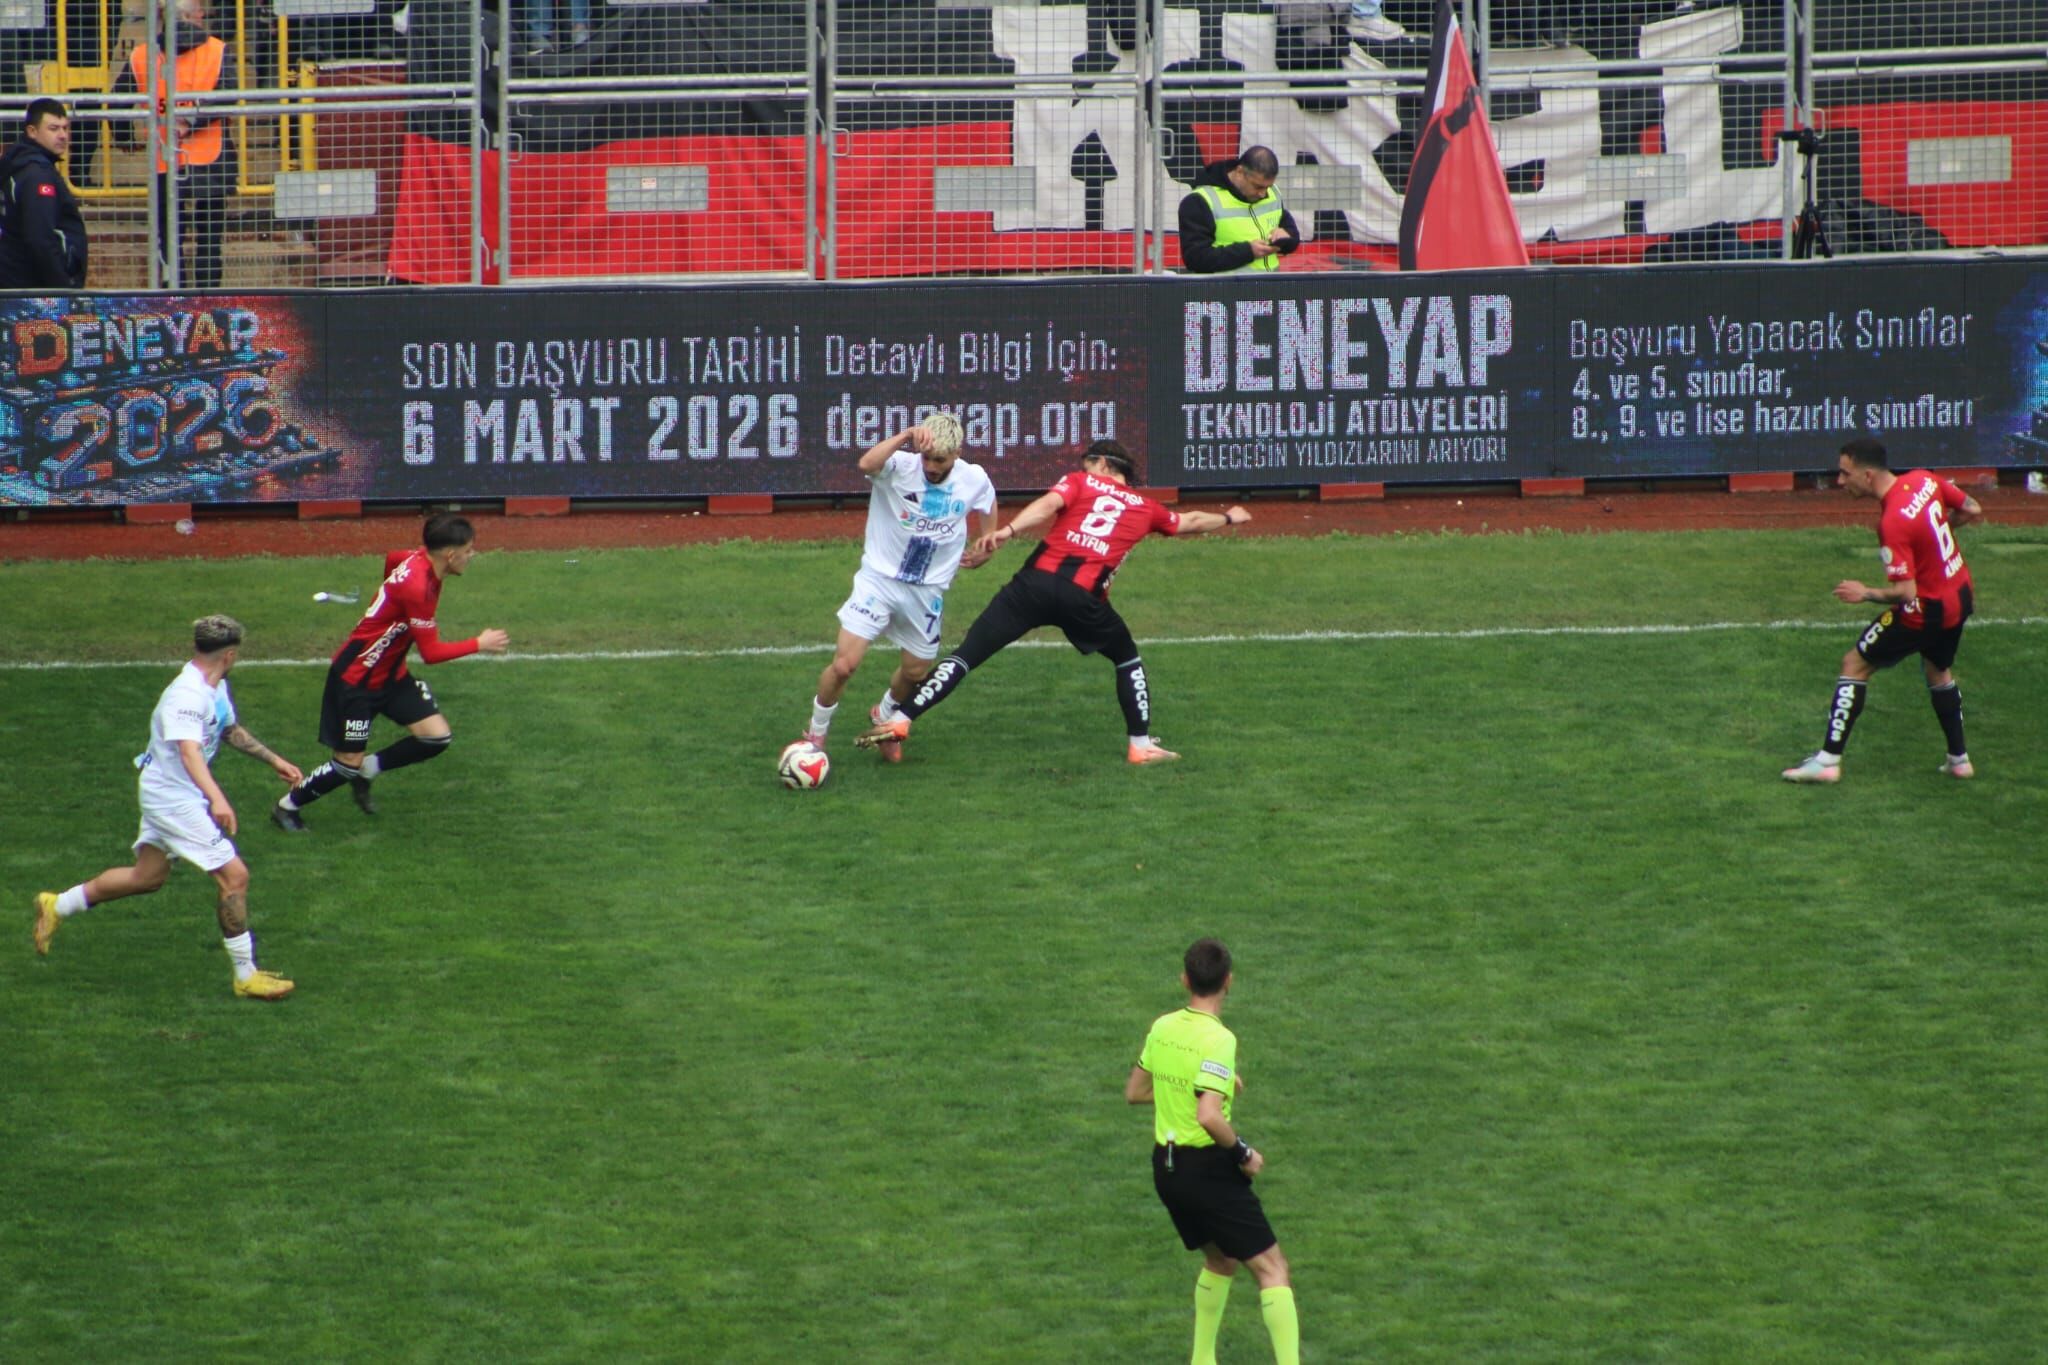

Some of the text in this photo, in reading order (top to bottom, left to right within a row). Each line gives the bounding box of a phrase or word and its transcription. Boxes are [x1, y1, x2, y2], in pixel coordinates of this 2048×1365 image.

[15, 308, 260, 377] DENEYAP
[403, 324, 801, 397] SON BAŞVURU TARİHİ
[826, 320, 1117, 383] Detaylı Bilgi İçin:
[1184, 294, 1512, 393] DENEYAP
[1570, 306, 1973, 365] Başvuru Yapacak Sınıflar
[1572, 362, 1793, 400] 4. ve 5. sınıflar,
[36, 371, 284, 488] 2026
[402, 394, 799, 465] 6 MART 2026
[826, 392, 1117, 457] denap.org
[1181, 389, 1508, 439] TEKNOLOJİ ATÖLYELERİ
[1571, 393, 1974, 443] 8., 9. ve lise hazırlık sınıfları
[1183, 436, 1507, 470] GELECEĞİN YILDIZLARINI ARIYOR!
[1066, 530, 1110, 557] TAYFUN
[1080, 495, 1126, 537] 8
[1928, 500, 1956, 562] 6
[925, 613, 938, 634] 7
[1864, 621, 1884, 645] 6
